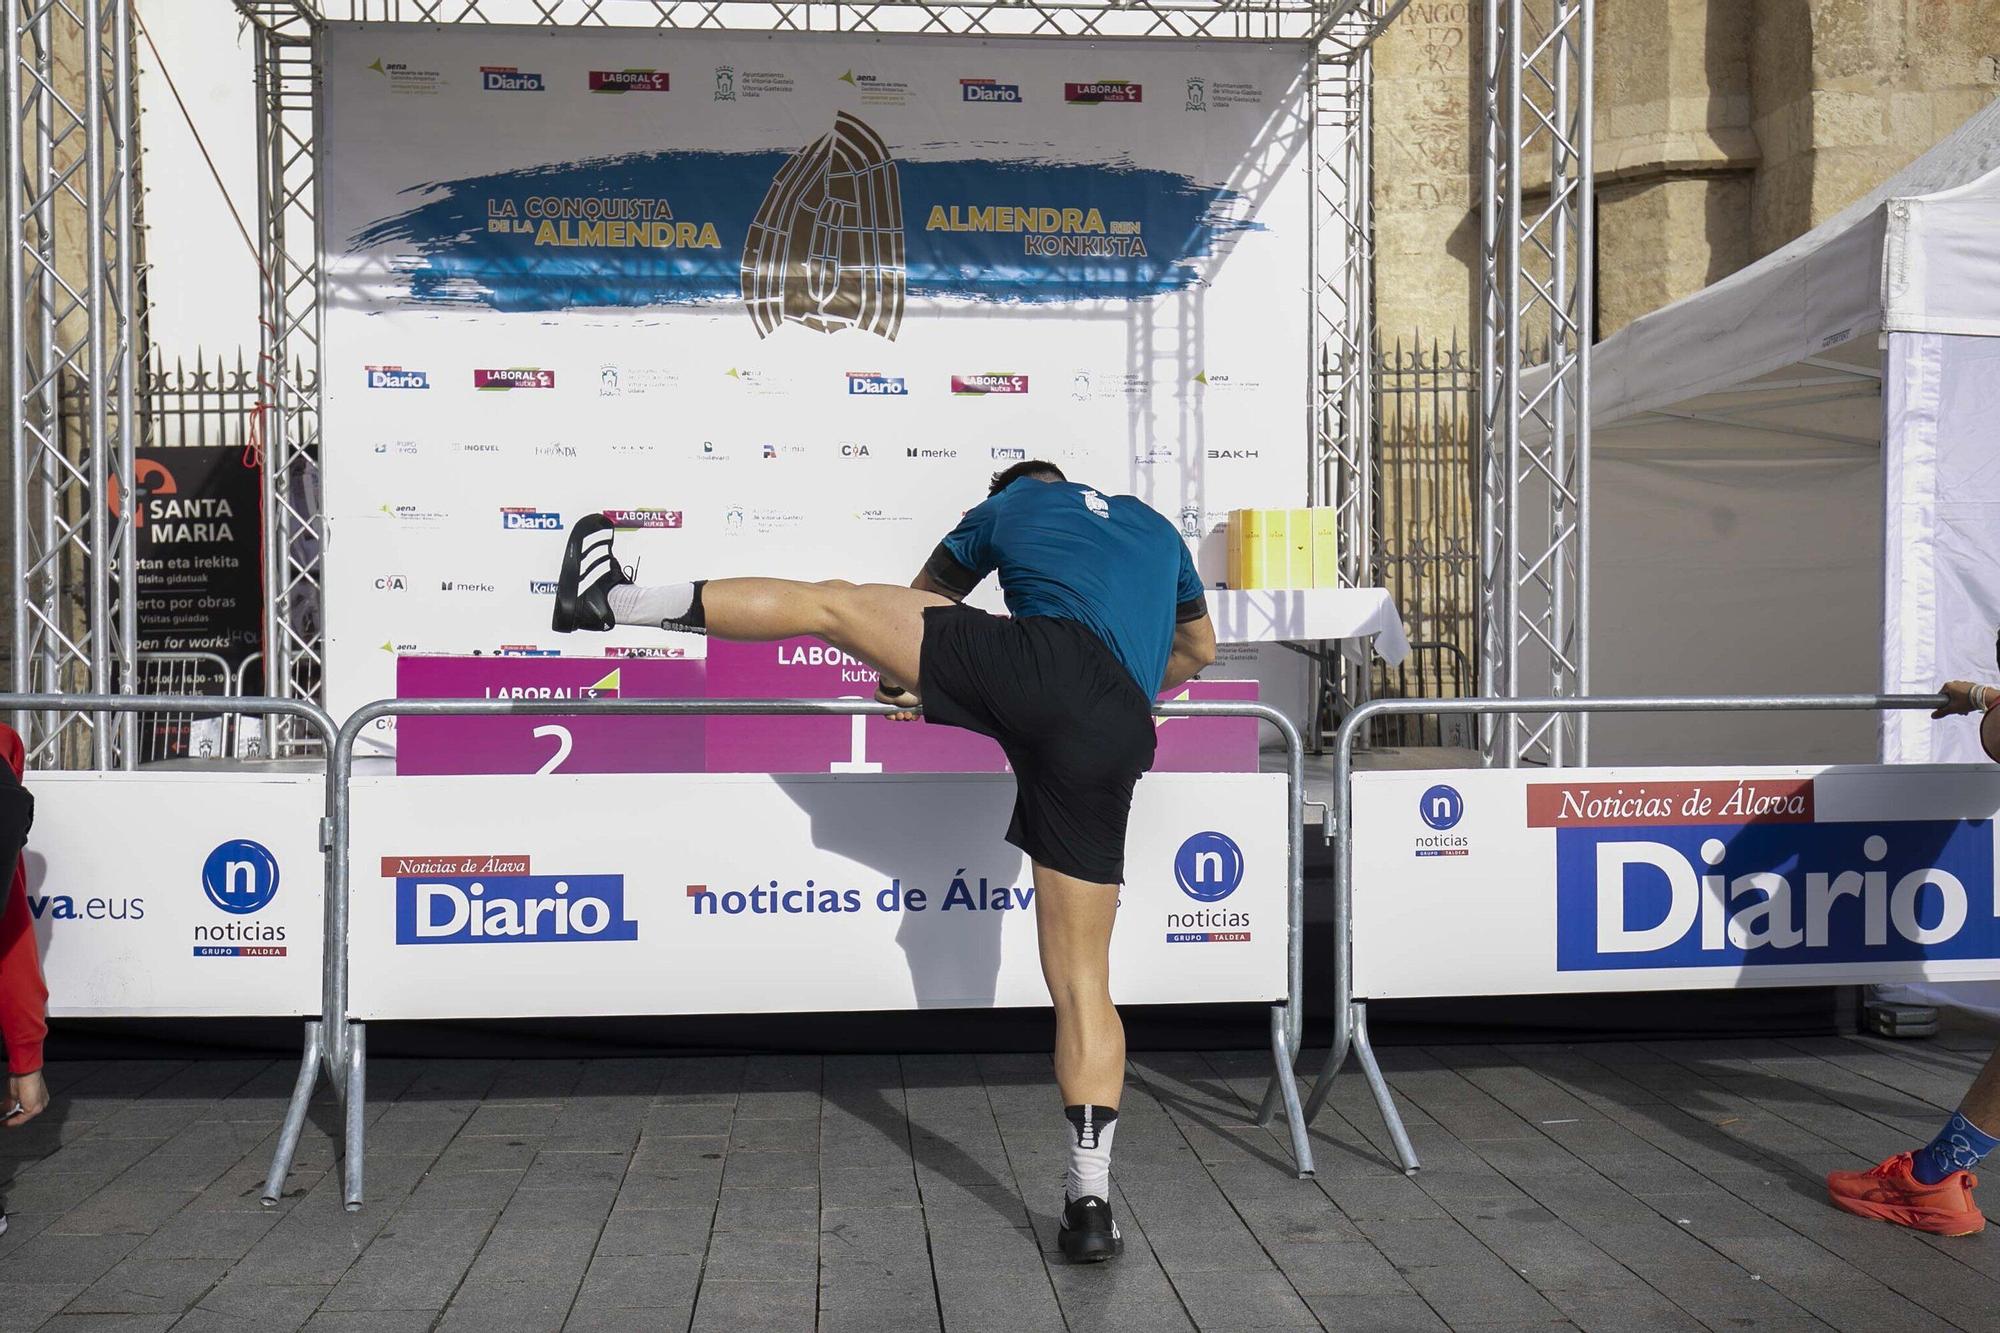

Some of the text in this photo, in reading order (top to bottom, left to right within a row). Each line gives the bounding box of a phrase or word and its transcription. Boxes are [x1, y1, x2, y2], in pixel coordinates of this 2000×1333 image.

[488, 73, 539, 90] Diario
[602, 73, 650, 83] LABORAL
[967, 85, 1016, 101] Diario
[1077, 85, 1124, 94] LABORAL
[488, 196, 673, 222] LA CONQUISTA
[925, 205, 1107, 235] ALMENDRA
[488, 219, 722, 249] DE LA ALMENDRA
[1024, 234, 1148, 258] KONKISTA
[372, 371, 424, 388] Diario
[486, 370, 536, 380] LABORAL
[963, 376, 1010, 386] LABORAL
[514, 379, 536, 388] kutxa
[853, 377, 902, 393] Diario
[921, 448, 957, 458] merke
[993, 448, 1023, 459] Kaiku
[150, 498, 233, 519] SANTA
[396, 504, 417, 512] aena
[615, 511, 663, 520] LABORAL
[507, 513, 558, 529] Diario
[151, 522, 234, 544] MARIA
[167, 557, 190, 570] eta
[194, 555, 240, 568] irekita
[138, 573, 208, 585] Bisita gidatuak
[456, 581, 495, 592] merke
[532, 581, 559, 593] Kaik
[137, 595, 236, 611] erto por obras
[140, 613, 210, 625] Visitas guiadas
[135, 640, 159, 650] pen
[164, 635, 184, 649] for
[188, 635, 230, 649] works
[617, 648, 666, 657] LABORAL
[778, 645, 863, 666] LABO
[213, 672, 238, 682] 190
[533, 724, 573, 775] 2
[1557, 779, 1806, 820] Noticias de Álava
[1415, 834, 1469, 847] noticias
[397, 855, 526, 875] Noticias de Álava
[693, 868, 1035, 915] noticias de Álav
[1596, 834, 1968, 954] Diario
[26, 895, 144, 920] va.eus
[415, 881, 611, 937] Diario
[1167, 908, 1250, 928] noticias
[194, 921, 286, 941] noticias
[1173, 933, 1246, 942] GRUPO TALDEA
[200, 947, 281, 956] GRUPO TALDEA
